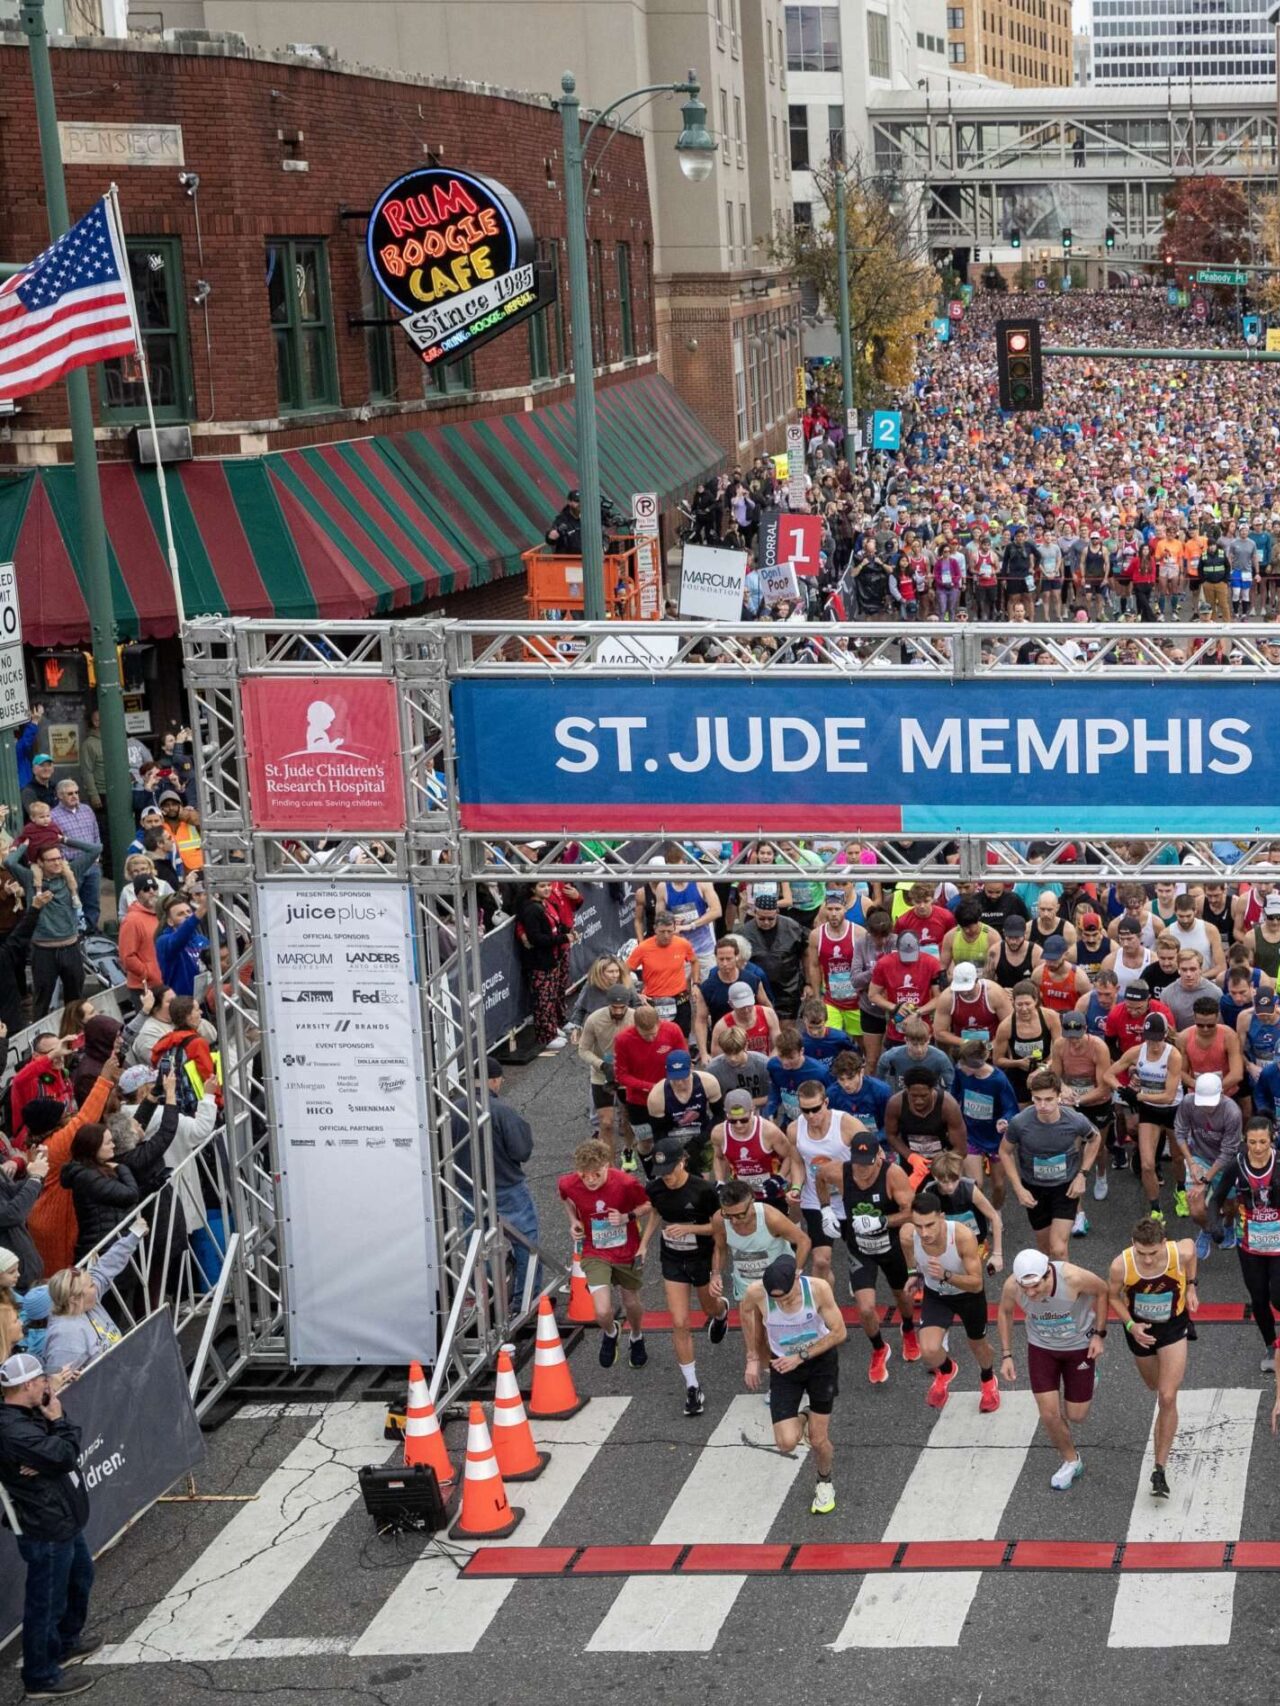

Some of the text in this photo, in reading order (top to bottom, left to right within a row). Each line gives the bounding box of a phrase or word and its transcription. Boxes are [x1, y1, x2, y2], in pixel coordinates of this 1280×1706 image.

[68, 131, 173, 154] BENSIECK
[383, 180, 478, 238] RUM
[381, 208, 499, 277] BOOGIE
[409, 246, 495, 302] CAFE
[1199, 273, 1231, 283] Peabody
[411, 267, 532, 344] Since 1985
[952, 304, 961, 315] 5
[866, 415, 874, 444] CORRAL
[880, 419, 896, 442] 2
[765, 520, 778, 567] CORRAL
[788, 528, 811, 563] 1
[683, 569, 742, 590] MARCUM
[682, 583, 741, 597] FOUNDATION
[1, 654, 12, 668] NO
[5, 691, 15, 702] OR
[0, 703, 26, 719] BUSES
[555, 716, 657, 773] ST.
[669, 716, 867, 773] JUDE
[901, 717, 1252, 774] MEMPHIS
[265, 764, 385, 779] St. Jude Children's
[266, 780, 385, 796] Research Hospital
[272, 799, 300, 808] Finding
[325, 800, 350, 808] Saving
[352, 799, 384, 807] children.
[277, 953, 333, 965] MARCUM
[346, 952, 400, 964] LANDERS
[300, 990, 333, 1003] Shaw
[353, 989, 399, 1004] FedEx
[306, 1107, 333, 1115] HICO
